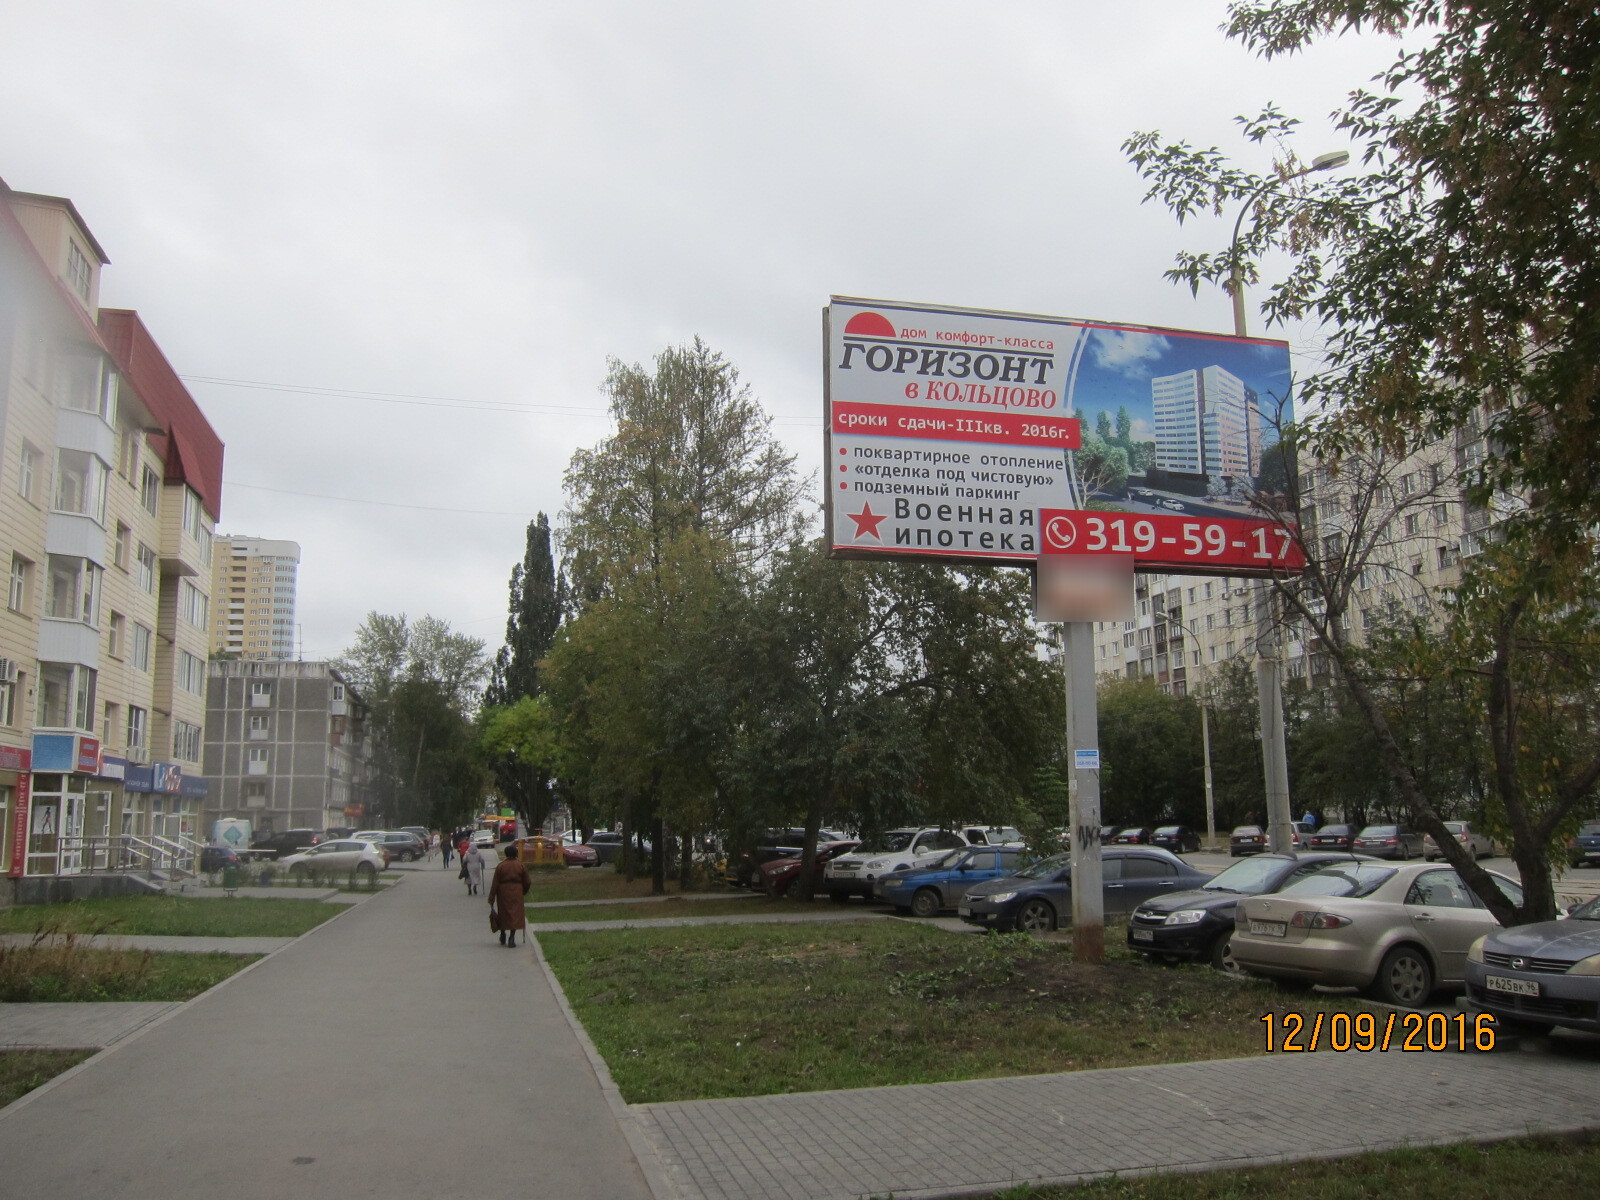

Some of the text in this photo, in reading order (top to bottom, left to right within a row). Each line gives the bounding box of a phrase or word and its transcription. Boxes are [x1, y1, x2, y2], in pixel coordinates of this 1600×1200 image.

[900, 328, 1054, 350] дом комфорт-класса
[838, 342, 1054, 385] ГОРИЗОНТ
[904, 380, 1057, 410] в КОЛЬЦОВО
[838, 412, 888, 429] сроки
[1021, 424, 1070, 440] 2016г.
[854, 447, 1064, 470] поквартирное отопление
[854, 465, 1054, 487] «отделка под чистовую»
[854, 482, 1021, 501] подземный паркинг
[894, 498, 1034, 526] Военная
[894, 527, 1035, 551] ипотека
[1087, 517, 1293, 560] 319-59-17
